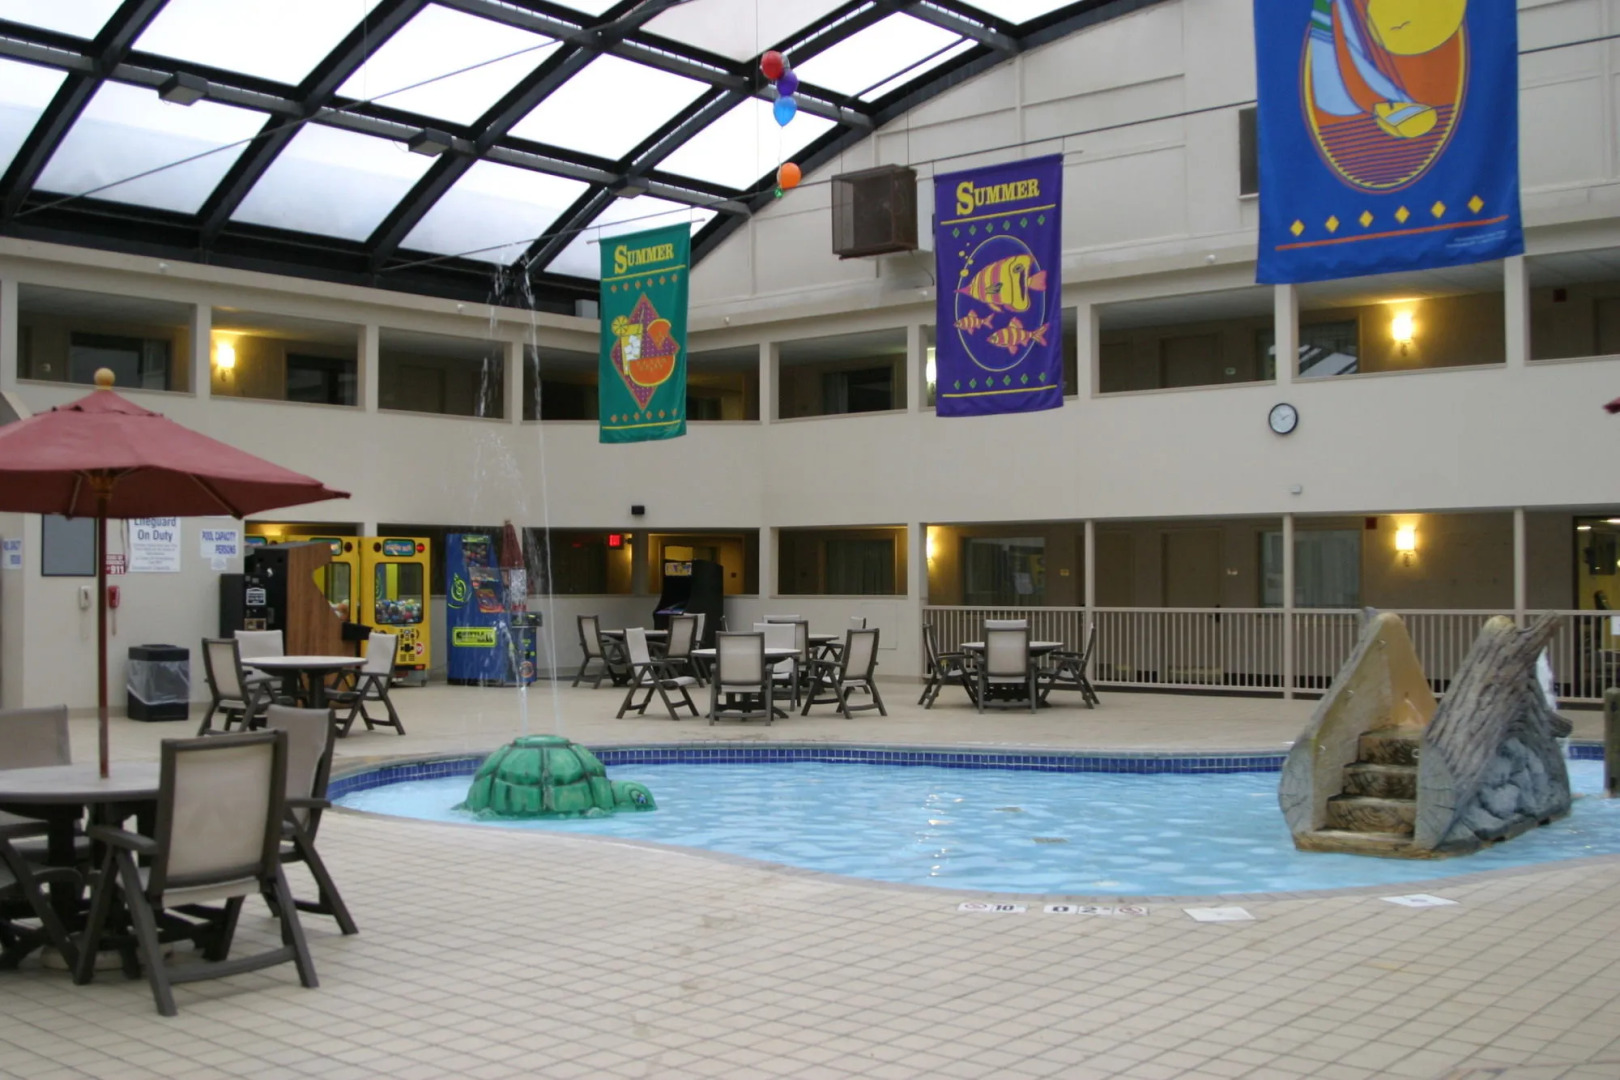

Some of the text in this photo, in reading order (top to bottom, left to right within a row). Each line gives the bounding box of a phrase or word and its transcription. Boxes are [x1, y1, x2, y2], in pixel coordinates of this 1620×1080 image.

[956, 178, 1040, 216] SUMMER
[614, 243, 675, 274] SUMMER
[137, 529, 173, 542] On Duty
[110, 564, 124, 574] 911
